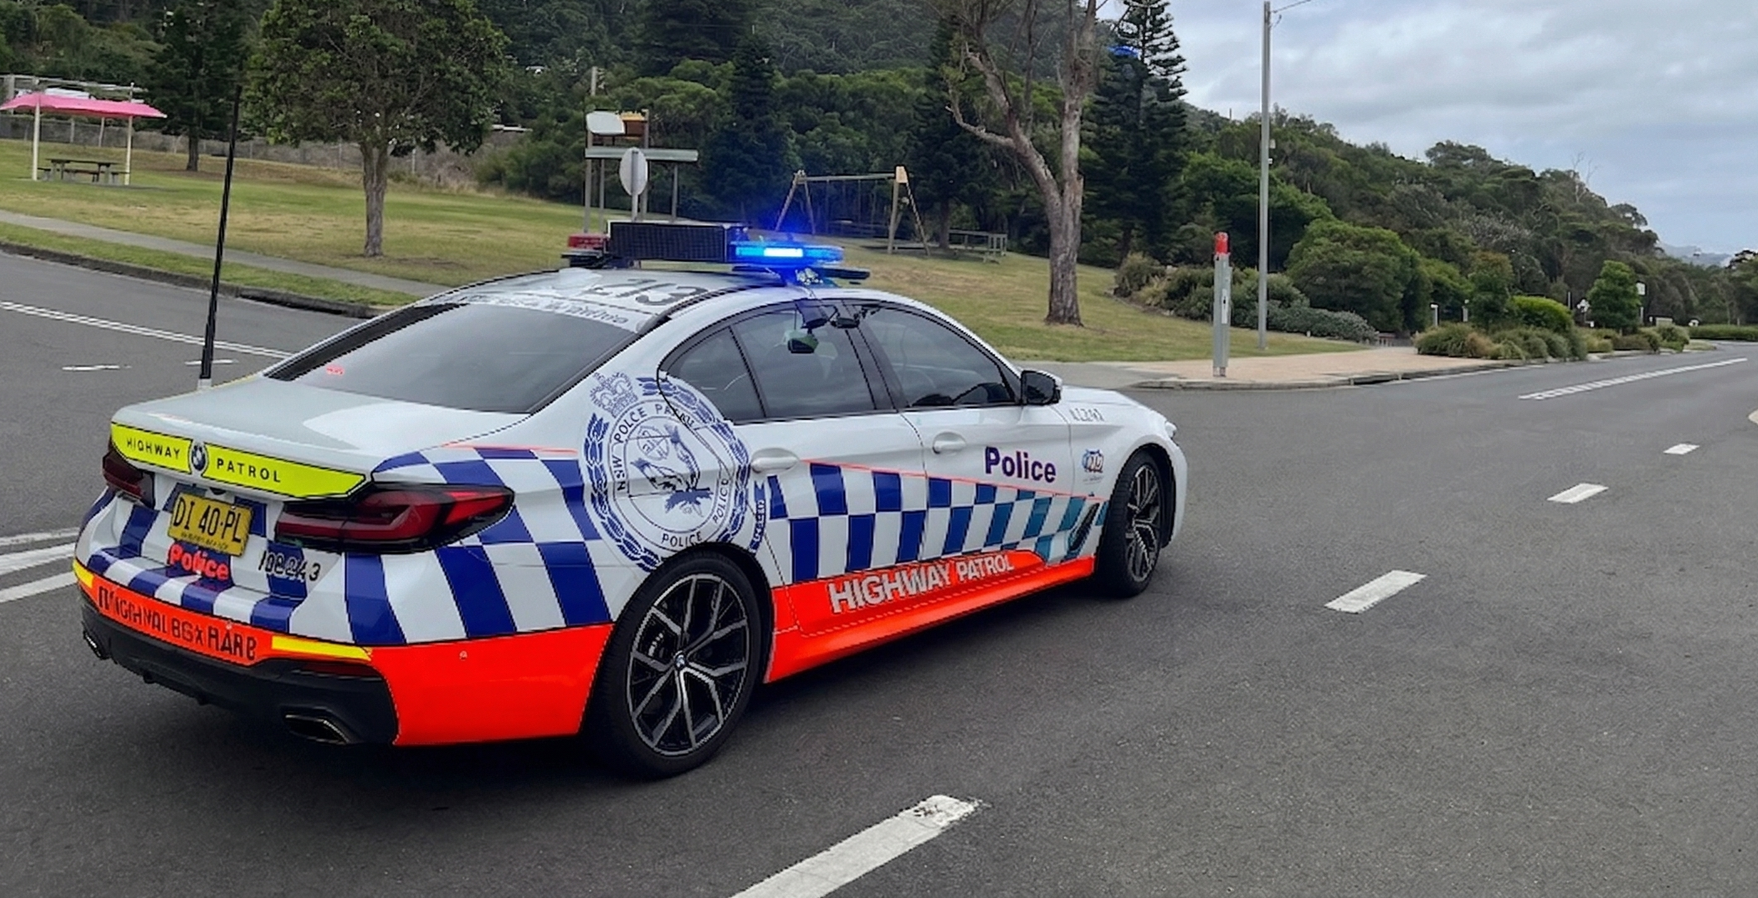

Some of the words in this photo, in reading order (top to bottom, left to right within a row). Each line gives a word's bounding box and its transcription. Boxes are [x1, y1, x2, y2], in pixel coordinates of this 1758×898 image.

[127, 437, 180, 460] HIGHWAY
[216, 458, 281, 483] PATROL
[984, 446, 1057, 484] Police
[169, 543, 229, 580] Police
[828, 562, 951, 614] HIGHWAY
[956, 554, 1015, 582] PATROL
